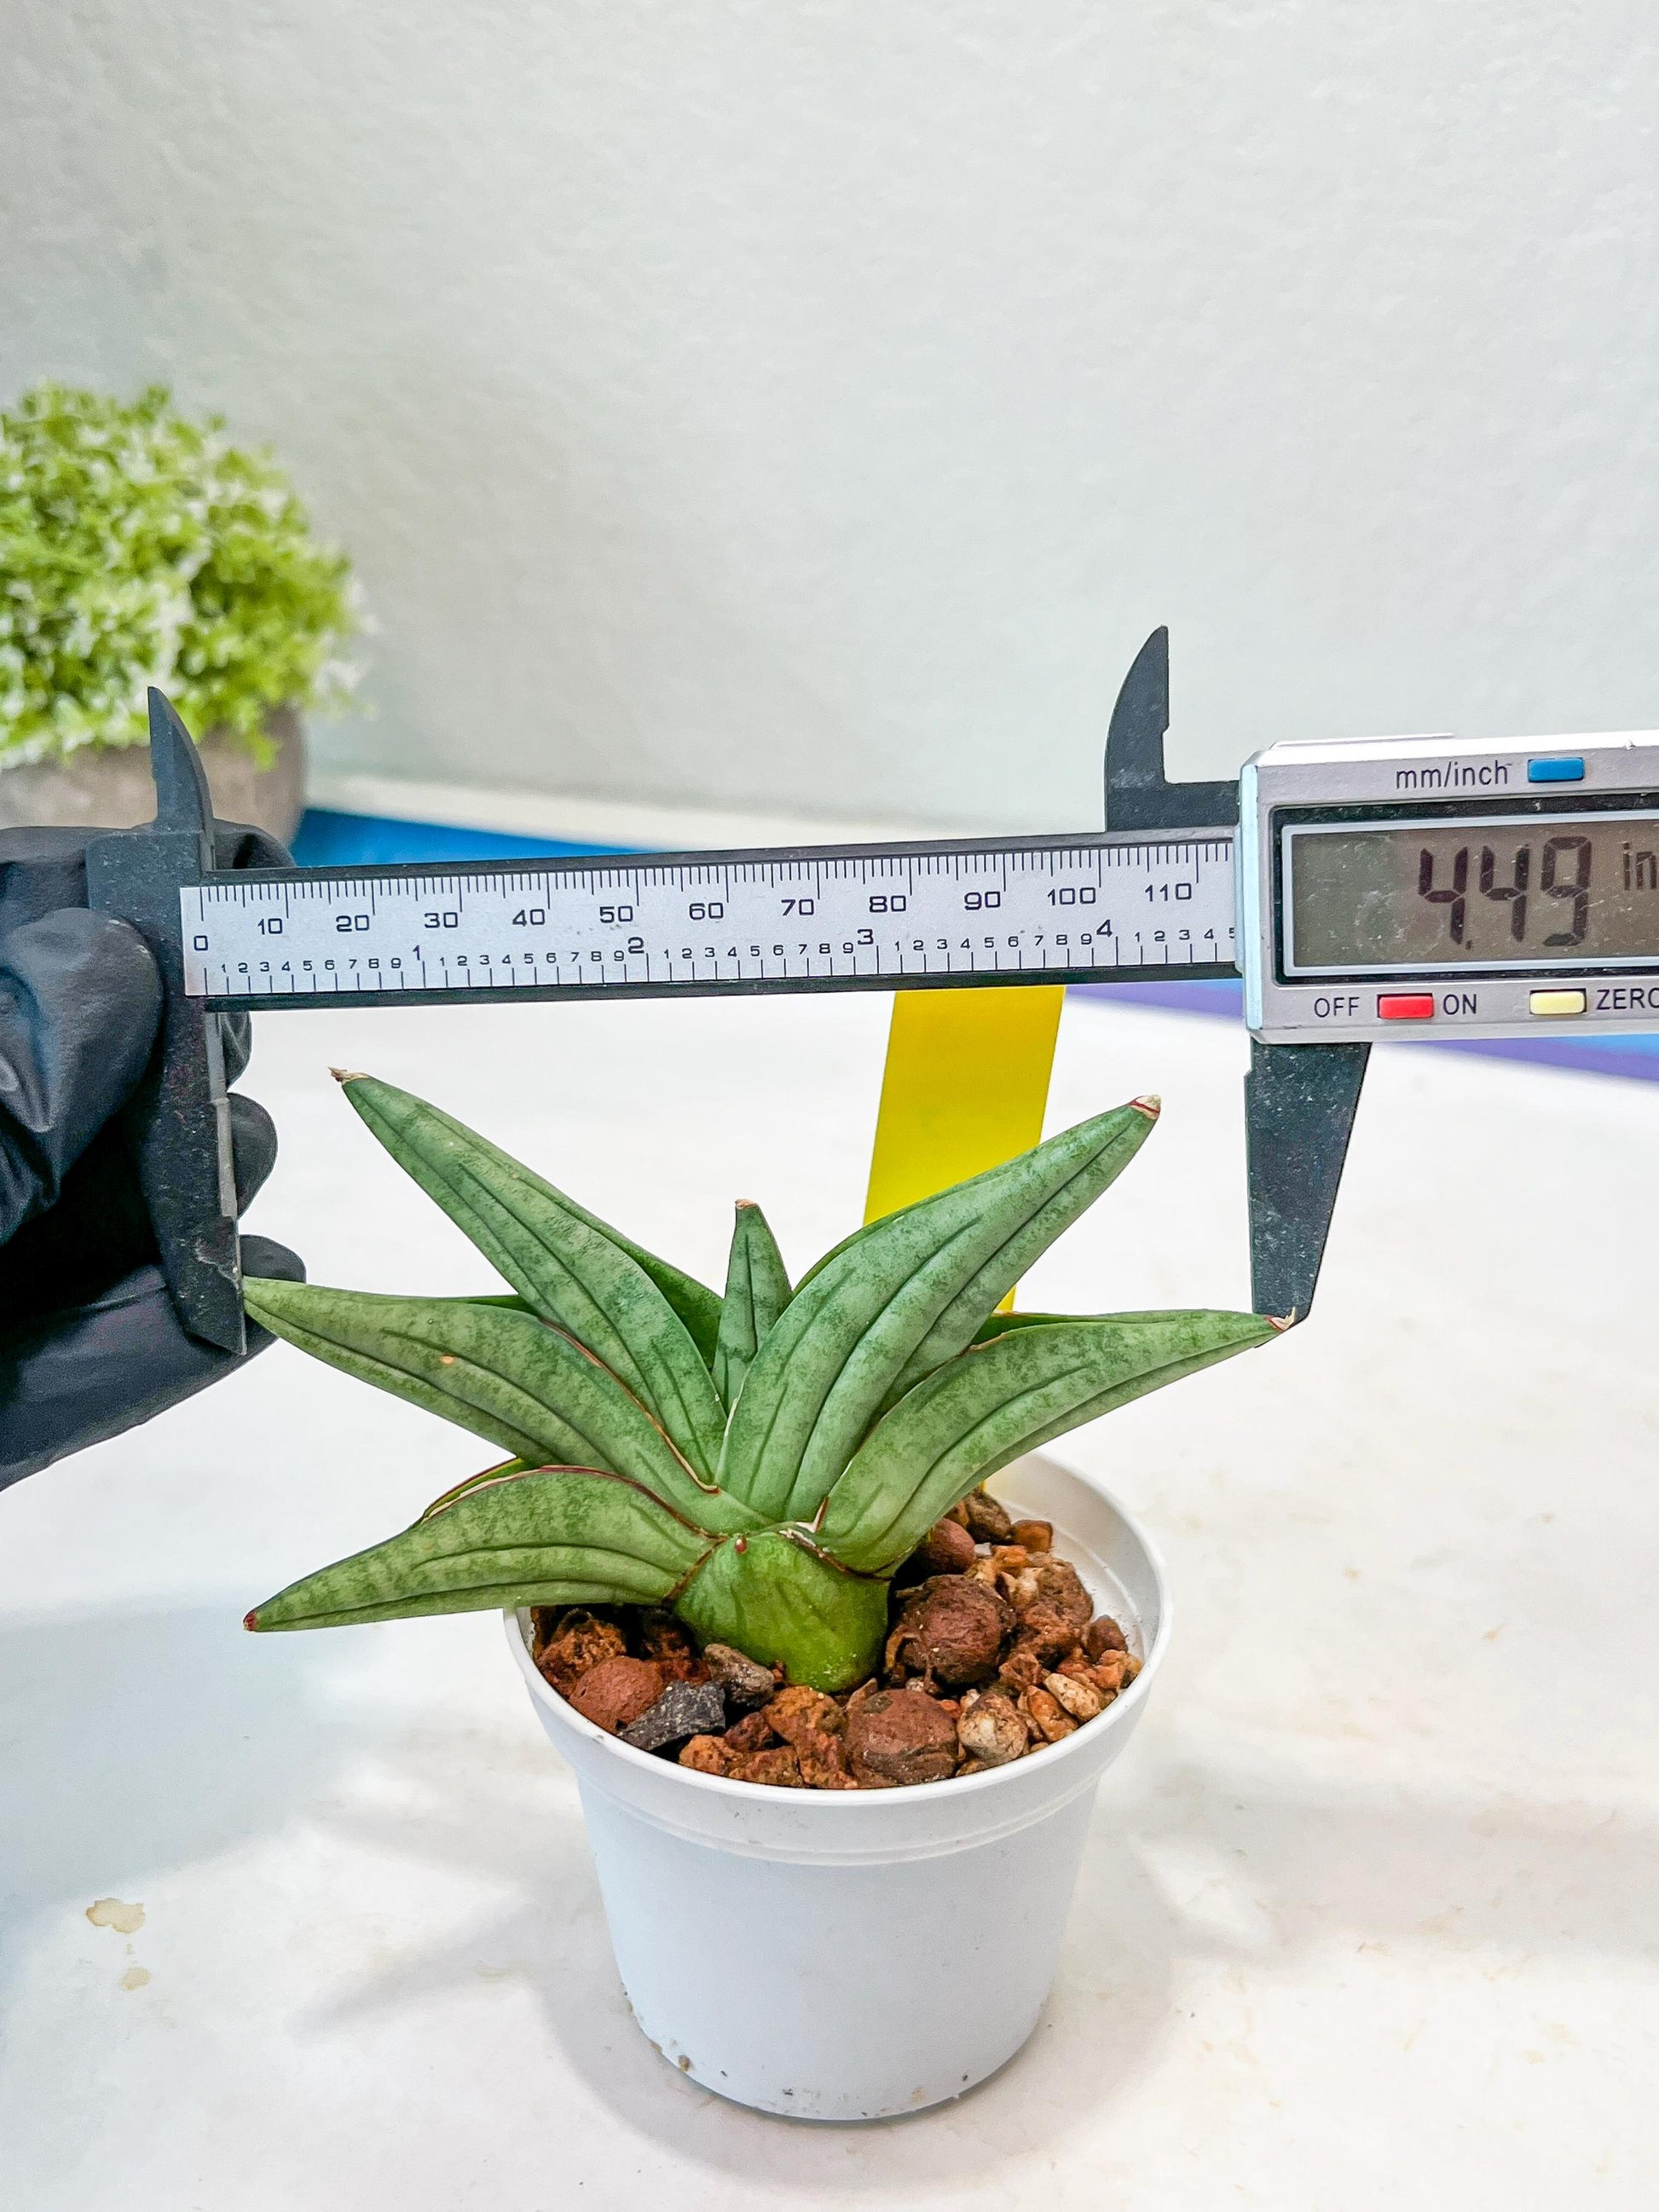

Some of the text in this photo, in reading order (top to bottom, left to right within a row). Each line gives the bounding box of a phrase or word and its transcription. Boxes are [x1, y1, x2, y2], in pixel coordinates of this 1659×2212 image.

[1396, 761, 1508, 788] mm/inch
[257, 882, 1193, 936] 10 20 30 40 50 60 70 80 90 100 110
[1419, 836, 1657, 950] 4.49 in
[193, 934, 209, 952] 0
[237, 962, 249, 973] 2
[259, 961, 270, 973] 3
[280, 961, 292, 973] 4
[303, 960, 313, 972] 5
[324, 959, 335, 971] 6
[348, 958, 358, 970] 7
[367, 957, 380, 969] 8
[390, 957, 402, 969] 9
[412, 944, 421, 962] 1
[456, 955, 468, 967] 2
[479, 954, 490, 966] 3
[501, 954, 512, 965] 4
[523, 952, 535, 965] 5
[546, 952, 558, 964] 6
[570, 951, 580, 962] 7
[590, 950, 603, 962] 8
[613, 950, 625, 962] 9
[627, 936, 645, 955] 2
[681, 947, 693, 960] 2
[704, 946, 715, 958] 3
[726, 946, 737, 958] 4
[749, 944, 760, 957] 5
[772, 944, 784, 956] 6
[797, 943, 808, 956] 7
[818, 943, 831, 955] 8
[842, 941, 854, 955] 9
[857, 928, 875, 945] 3
[912, 939, 924, 951] 2
[936, 939, 948, 950] 3
[960, 938, 971, 950] 4
[984, 936, 995, 949] 5
[1008, 935, 1020, 948] 6
[1033, 934, 1044, 947] 7
[1055, 933, 1068, 946] 8
[1080, 933, 1093, 945] 9
[1095, 919, 1113, 938] 4
[1153, 930, 1166, 943] 2
[1178, 929, 1191, 941] 3
[1203, 927, 1215, 940] 4
[1314, 996, 1360, 1018] OFF
[1442, 993, 1477, 1015] ON
